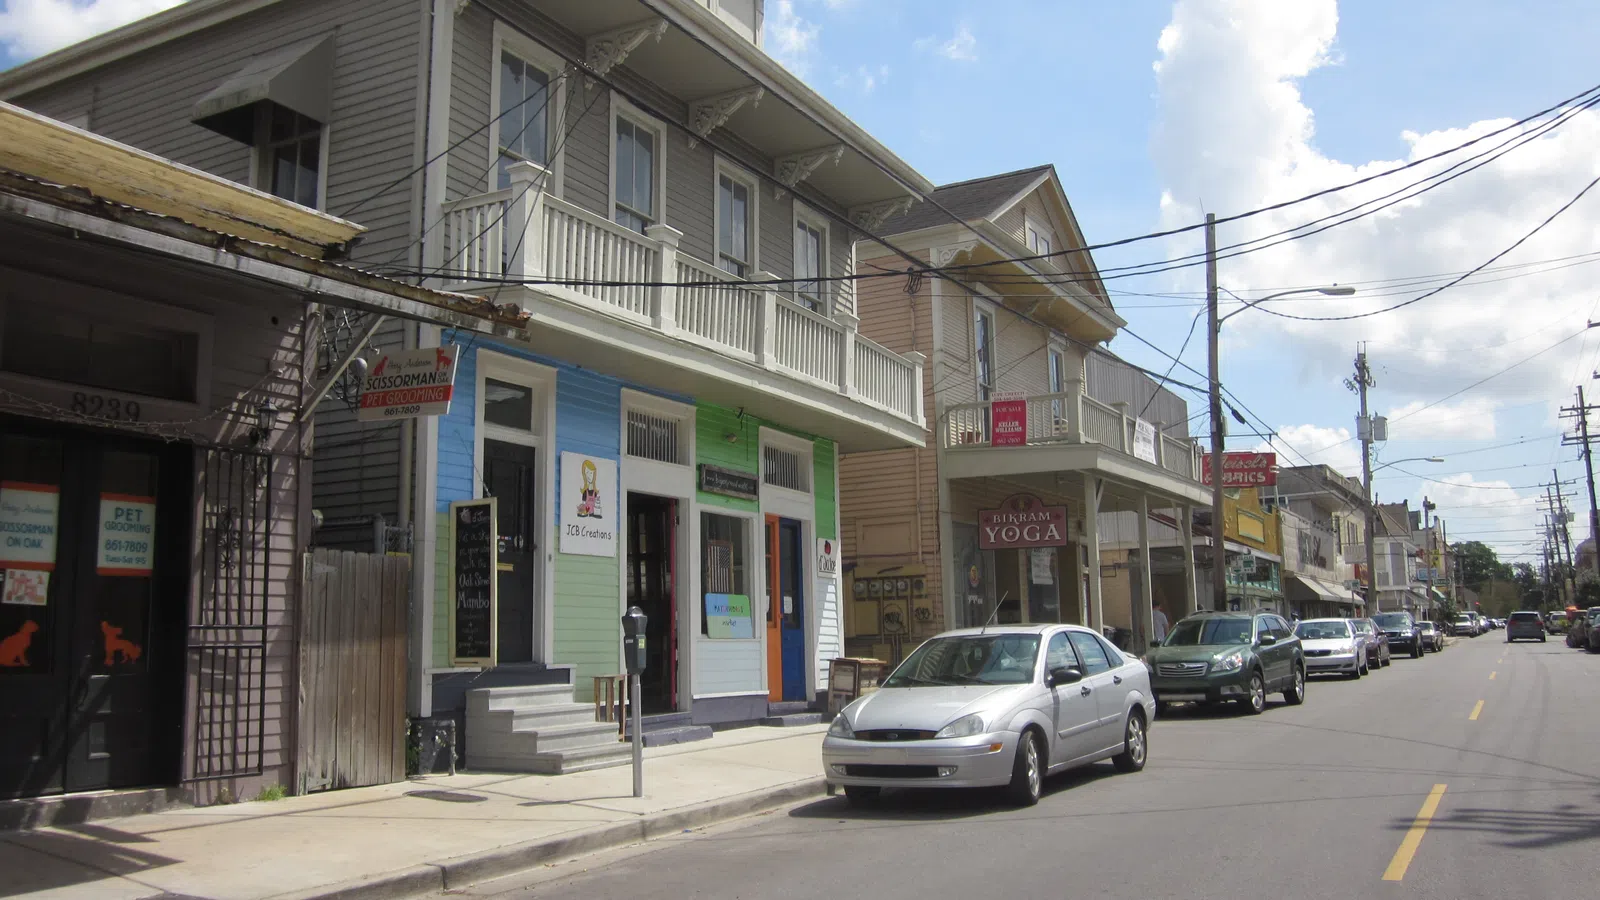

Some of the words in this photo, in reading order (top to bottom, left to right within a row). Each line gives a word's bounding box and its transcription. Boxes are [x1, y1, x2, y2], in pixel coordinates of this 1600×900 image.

[366, 372, 437, 391] SCISSORMAN
[366, 392, 384, 407] PET
[386, 387, 444, 405] GROOMING
[71, 391, 141, 422] 8239
[384, 405, 421, 416] 861-7809
[1205, 471, 1266, 483] FBRICS
[114, 507, 143, 522] PET
[993, 511, 1051, 525] BIKRAM
[104, 520, 151, 534] GROOMING
[566, 524, 580, 537] JCB
[581, 525, 612, 540] Creations
[985, 523, 1062, 543] YOGA
[6, 536, 21, 548] ON
[23, 537, 43, 549] OAK
[104, 539, 148, 553] 861-7809
[457, 591, 490, 609] Mambo
